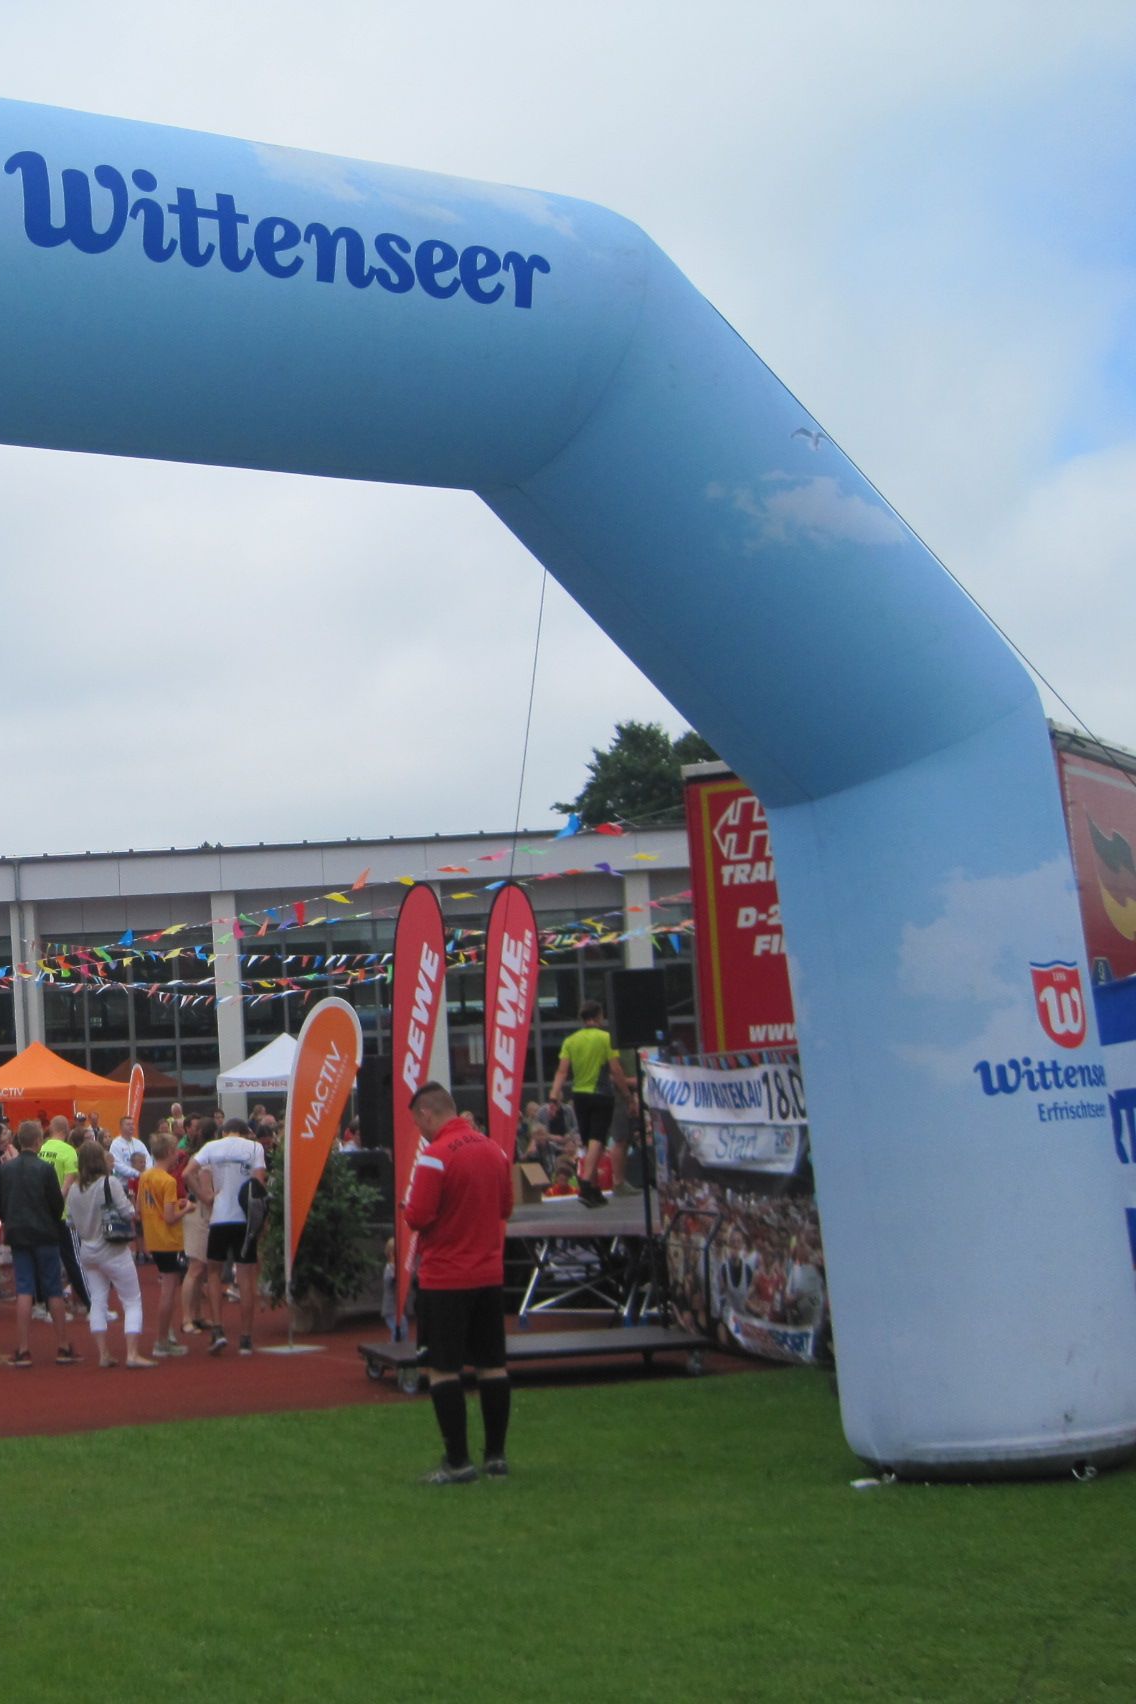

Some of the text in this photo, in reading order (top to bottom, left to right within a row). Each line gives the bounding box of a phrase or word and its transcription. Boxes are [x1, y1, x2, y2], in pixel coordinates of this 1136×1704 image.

[4, 150, 550, 309] Wittenseer
[721, 861, 775, 886] TRA
[403, 942, 439, 1095] REWE
[492, 932, 524, 1117] REWE
[517, 929, 533, 1024] CENTER
[301, 1041, 340, 1138] VIACTIV
[714, 1126, 757, 1161] Start
